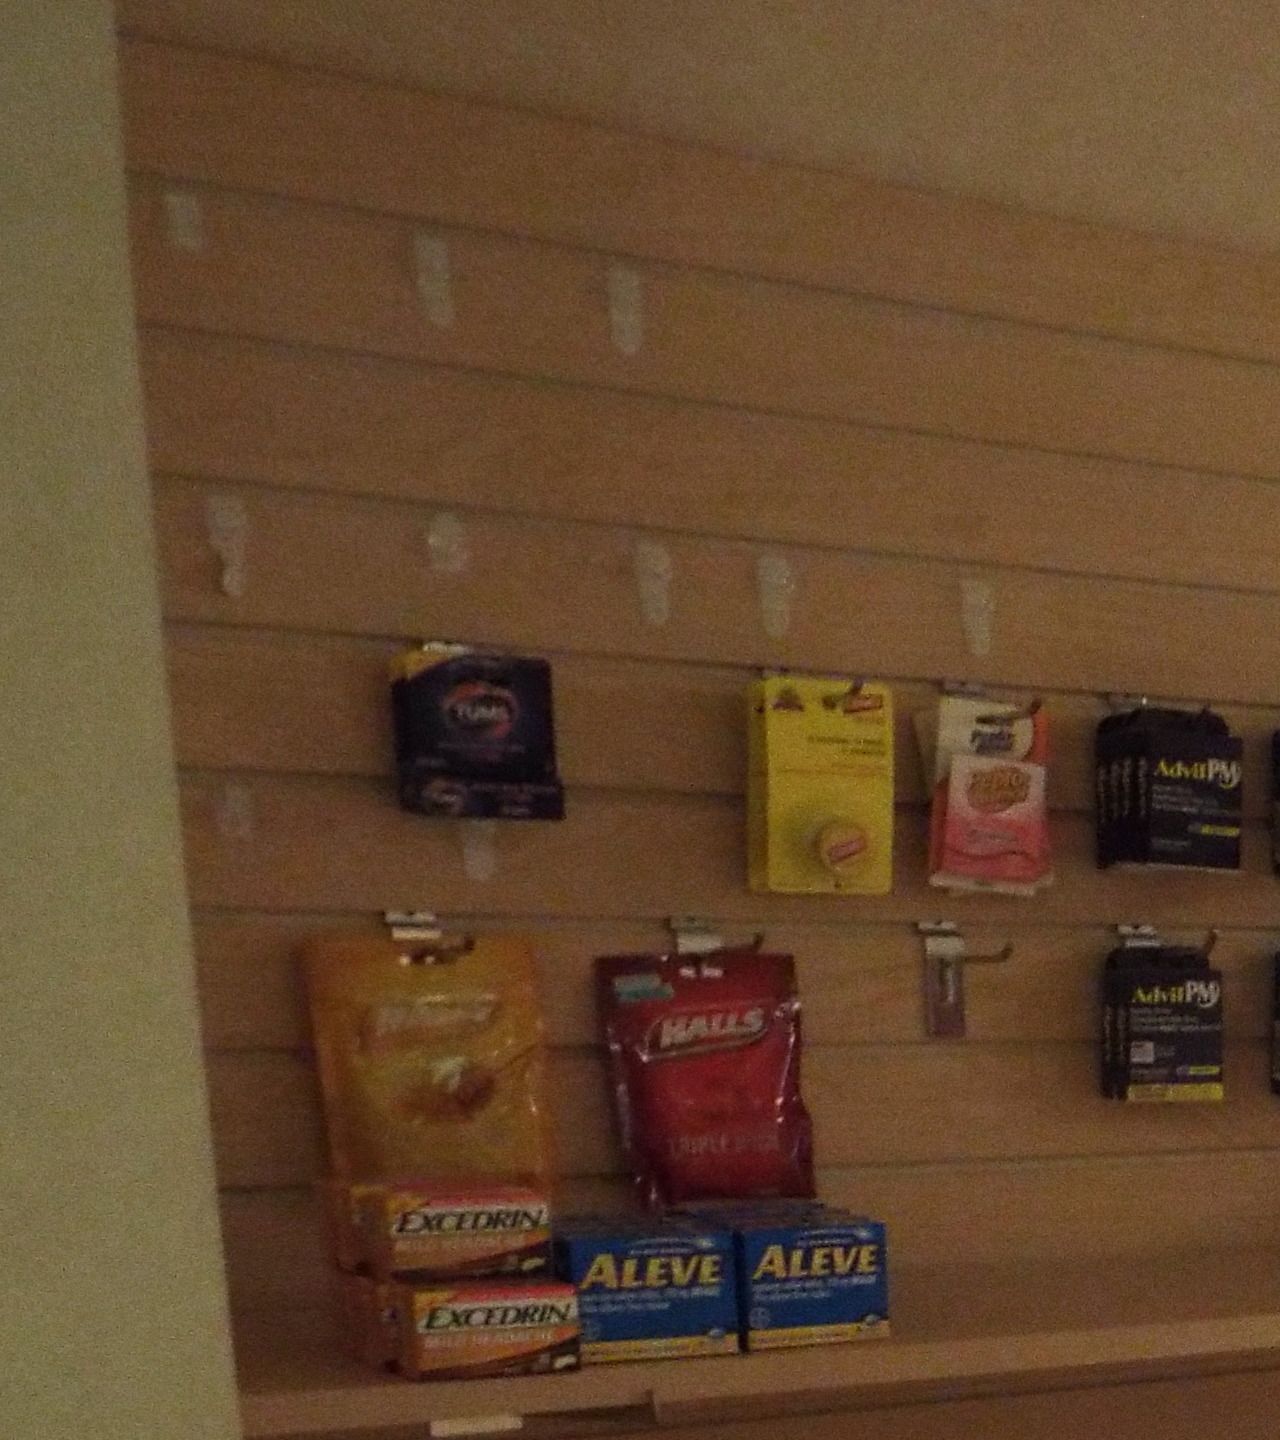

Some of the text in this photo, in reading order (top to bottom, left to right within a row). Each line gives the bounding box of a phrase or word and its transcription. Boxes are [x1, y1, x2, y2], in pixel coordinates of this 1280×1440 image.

[659, 1008, 765, 1048] HALLS
[396, 1208, 543, 1235] EXCEDRIN
[579, 1253, 724, 1291] ALEVE
[751, 1243, 881, 1281] ALEVE
[425, 1303, 572, 1330] EXCEDRIN
